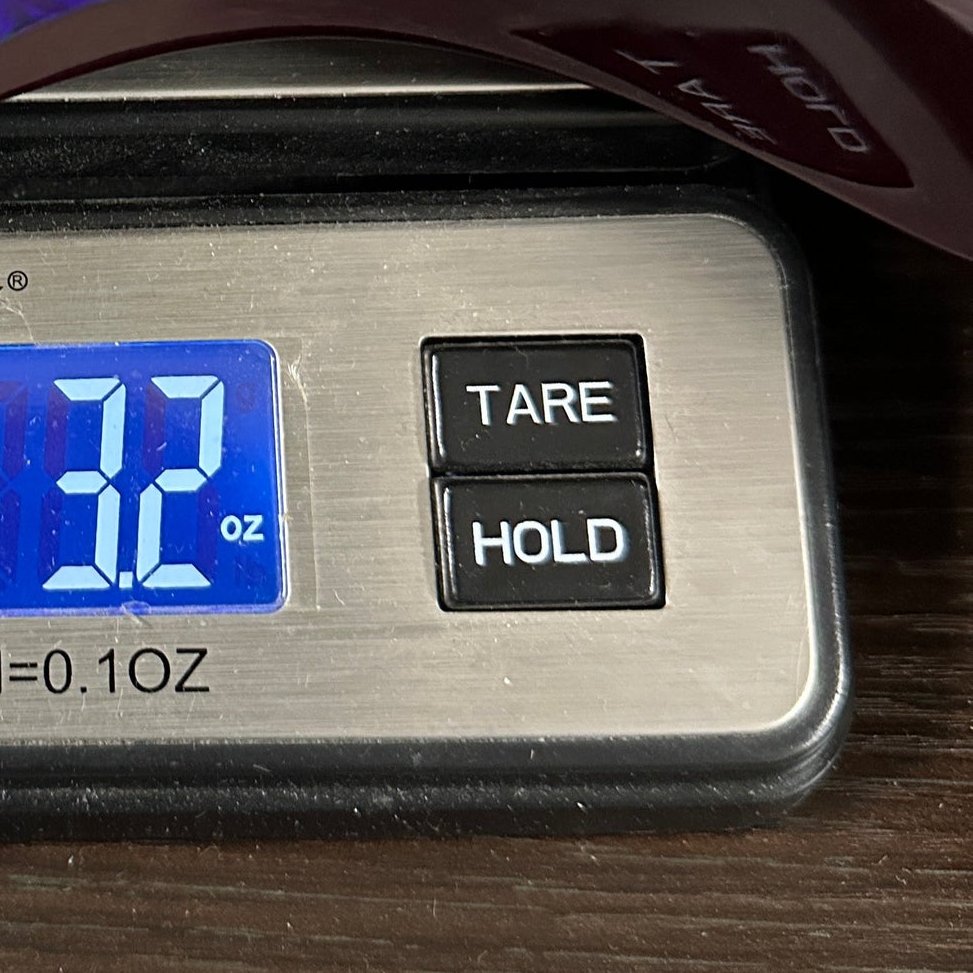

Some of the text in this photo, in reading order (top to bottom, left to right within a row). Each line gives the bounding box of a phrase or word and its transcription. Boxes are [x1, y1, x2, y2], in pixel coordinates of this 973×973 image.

[465, 381, 619, 426] TARE
[42, 375, 225, 589] 3.2
[220, 515, 264, 542] oz
[472, 518, 628, 567] HOLD
